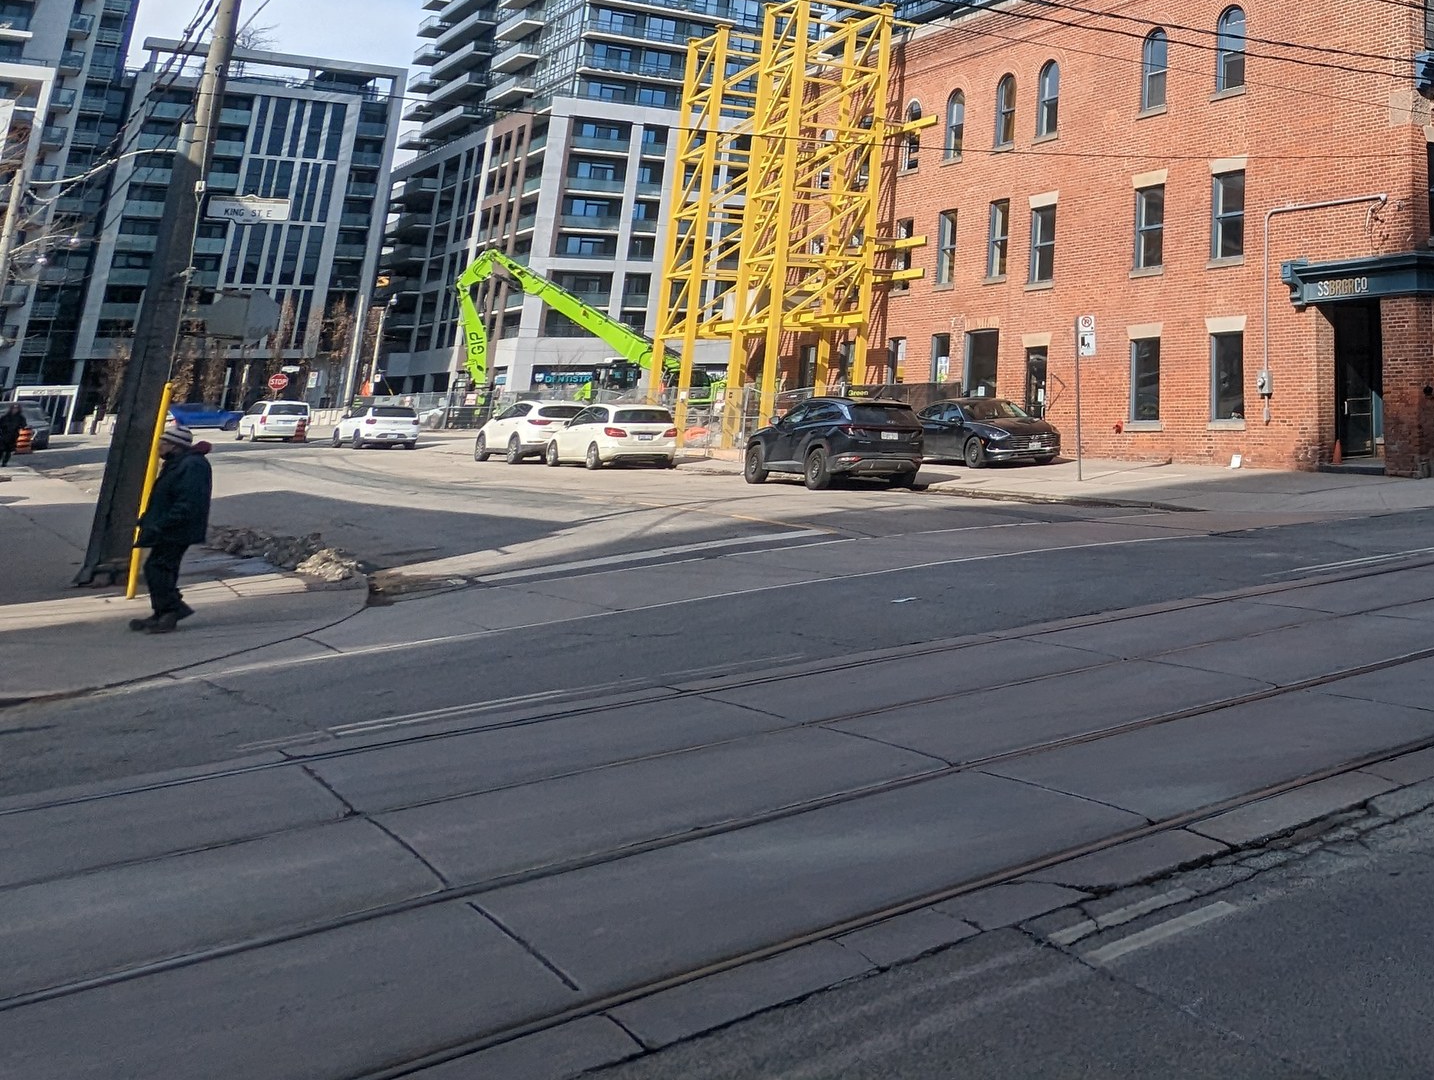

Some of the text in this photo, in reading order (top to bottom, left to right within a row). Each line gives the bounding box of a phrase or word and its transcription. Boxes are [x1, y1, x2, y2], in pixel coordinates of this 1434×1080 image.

[223, 207, 245, 218] KING
[266, 209, 273, 218] E
[469, 332, 485, 355] GIP
[544, 375, 593, 383] DENTISTR
[847, 389, 869, 397] Green
